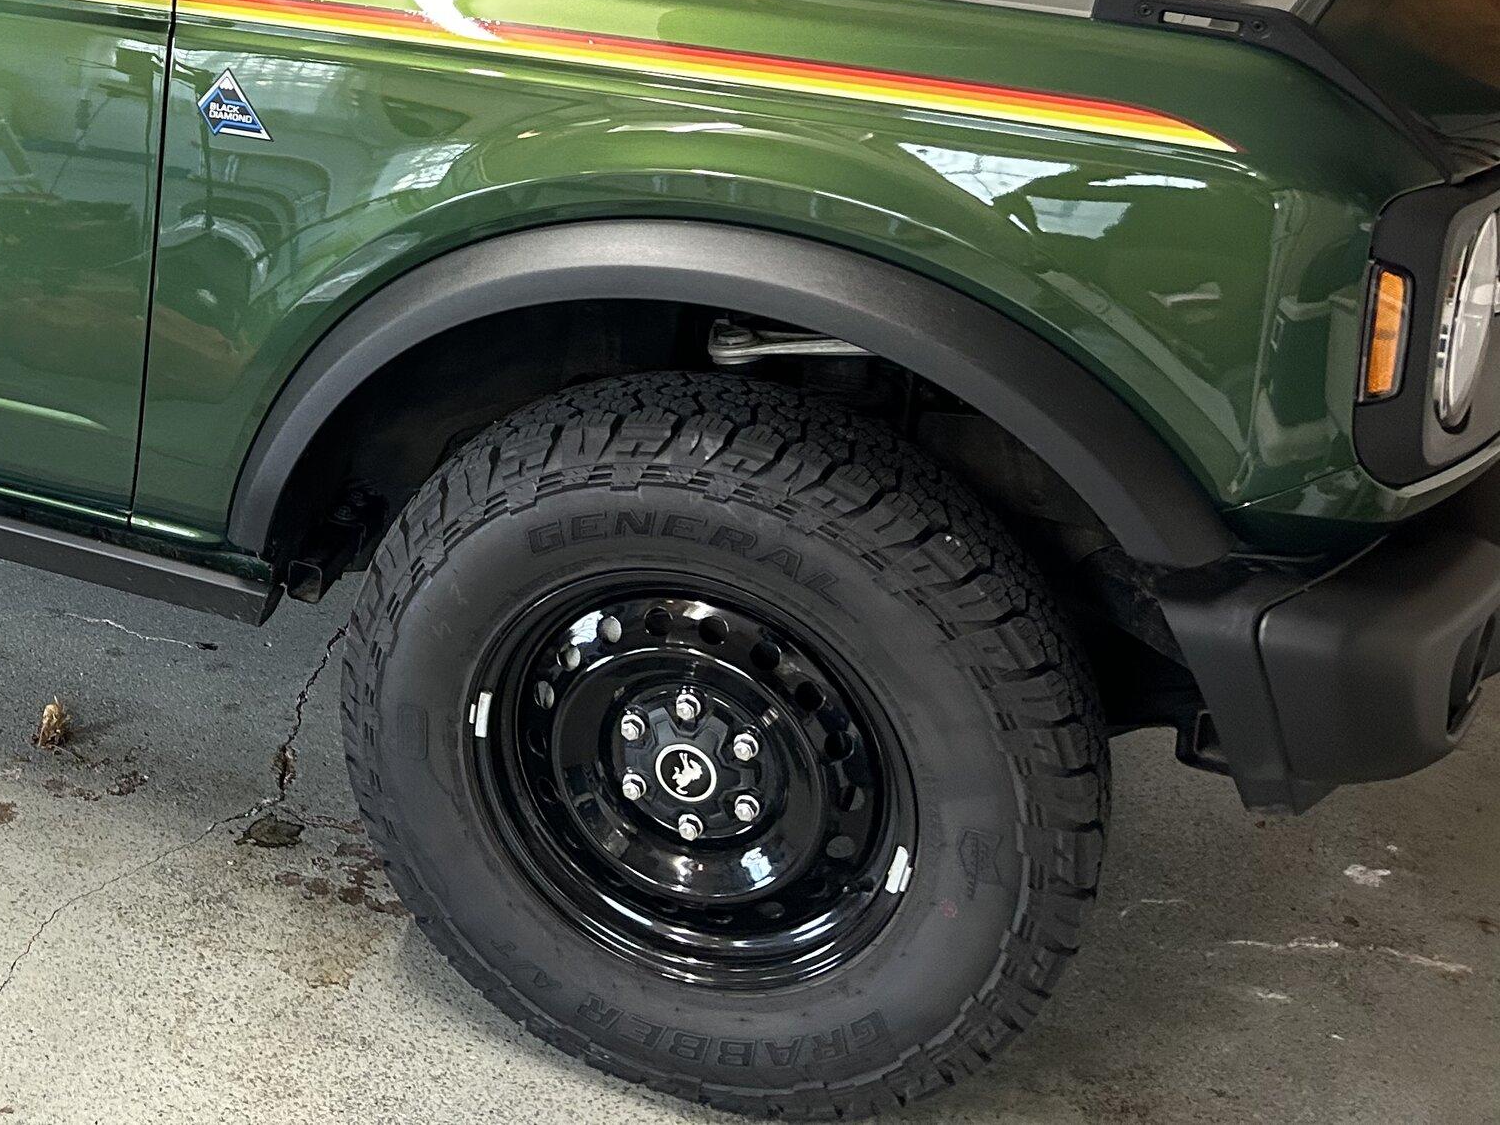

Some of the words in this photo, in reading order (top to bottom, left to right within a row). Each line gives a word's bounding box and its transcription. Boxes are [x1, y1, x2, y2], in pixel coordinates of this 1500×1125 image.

[208, 110, 253, 124] DIAMOND
[209, 102, 240, 114] BLACK
[527, 508, 843, 609] GENERAL
[574, 996, 889, 1068] GRABBER
